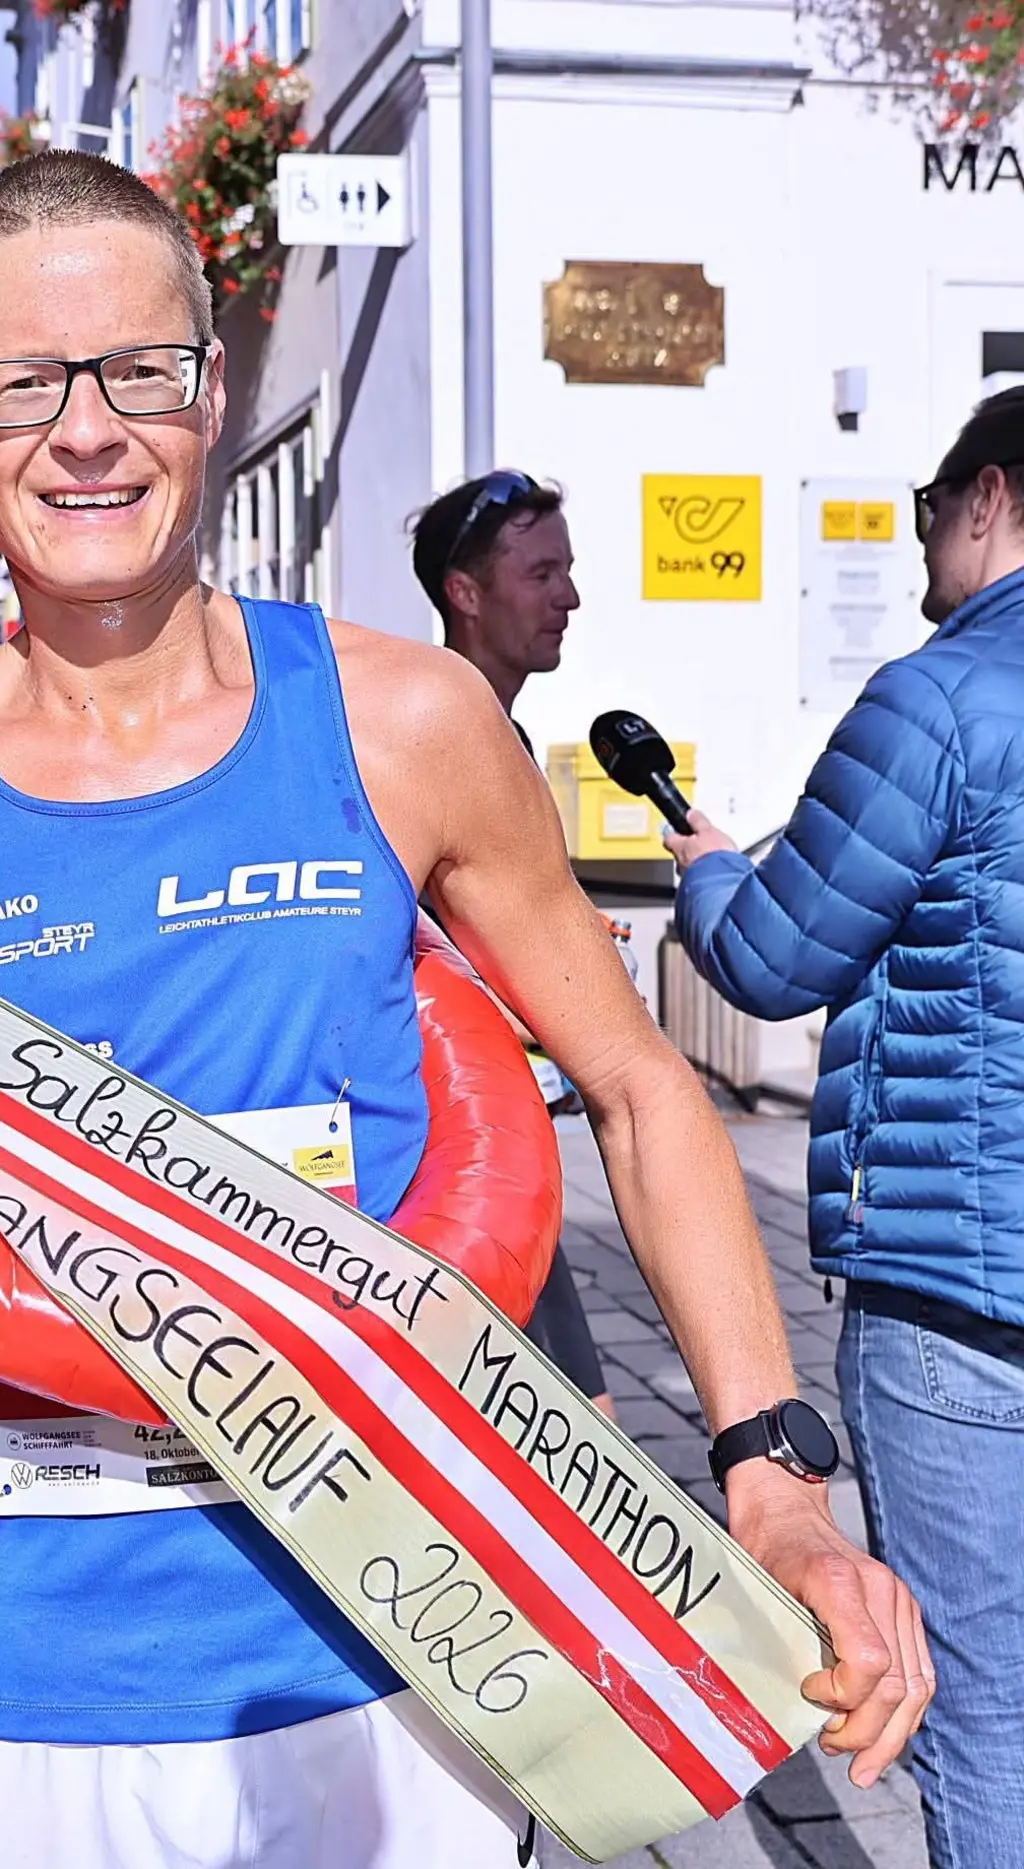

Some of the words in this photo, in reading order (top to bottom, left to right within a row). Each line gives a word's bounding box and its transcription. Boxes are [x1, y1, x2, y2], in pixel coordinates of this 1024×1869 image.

[923, 143, 1024, 191] MA
[657, 553, 705, 574] bank
[710, 550, 746, 580] 99
[42, 921, 95, 939] STEYR
[158, 910, 273, 935] LEICHTATHLETIKCLUB
[273, 906, 329, 921] AMATEURE
[330, 906, 362, 917] STEYR
[22, 1430, 81, 1441] WOLFGANGSEE
[23, 1440, 74, 1450] SCHIFFFAHRT
[144, 1450, 160, 1461] 18.
[35, 1463, 101, 1481] RESCH
[458, 1323, 722, 1620] MARATHON
[359, 1543, 549, 1714] 2026
